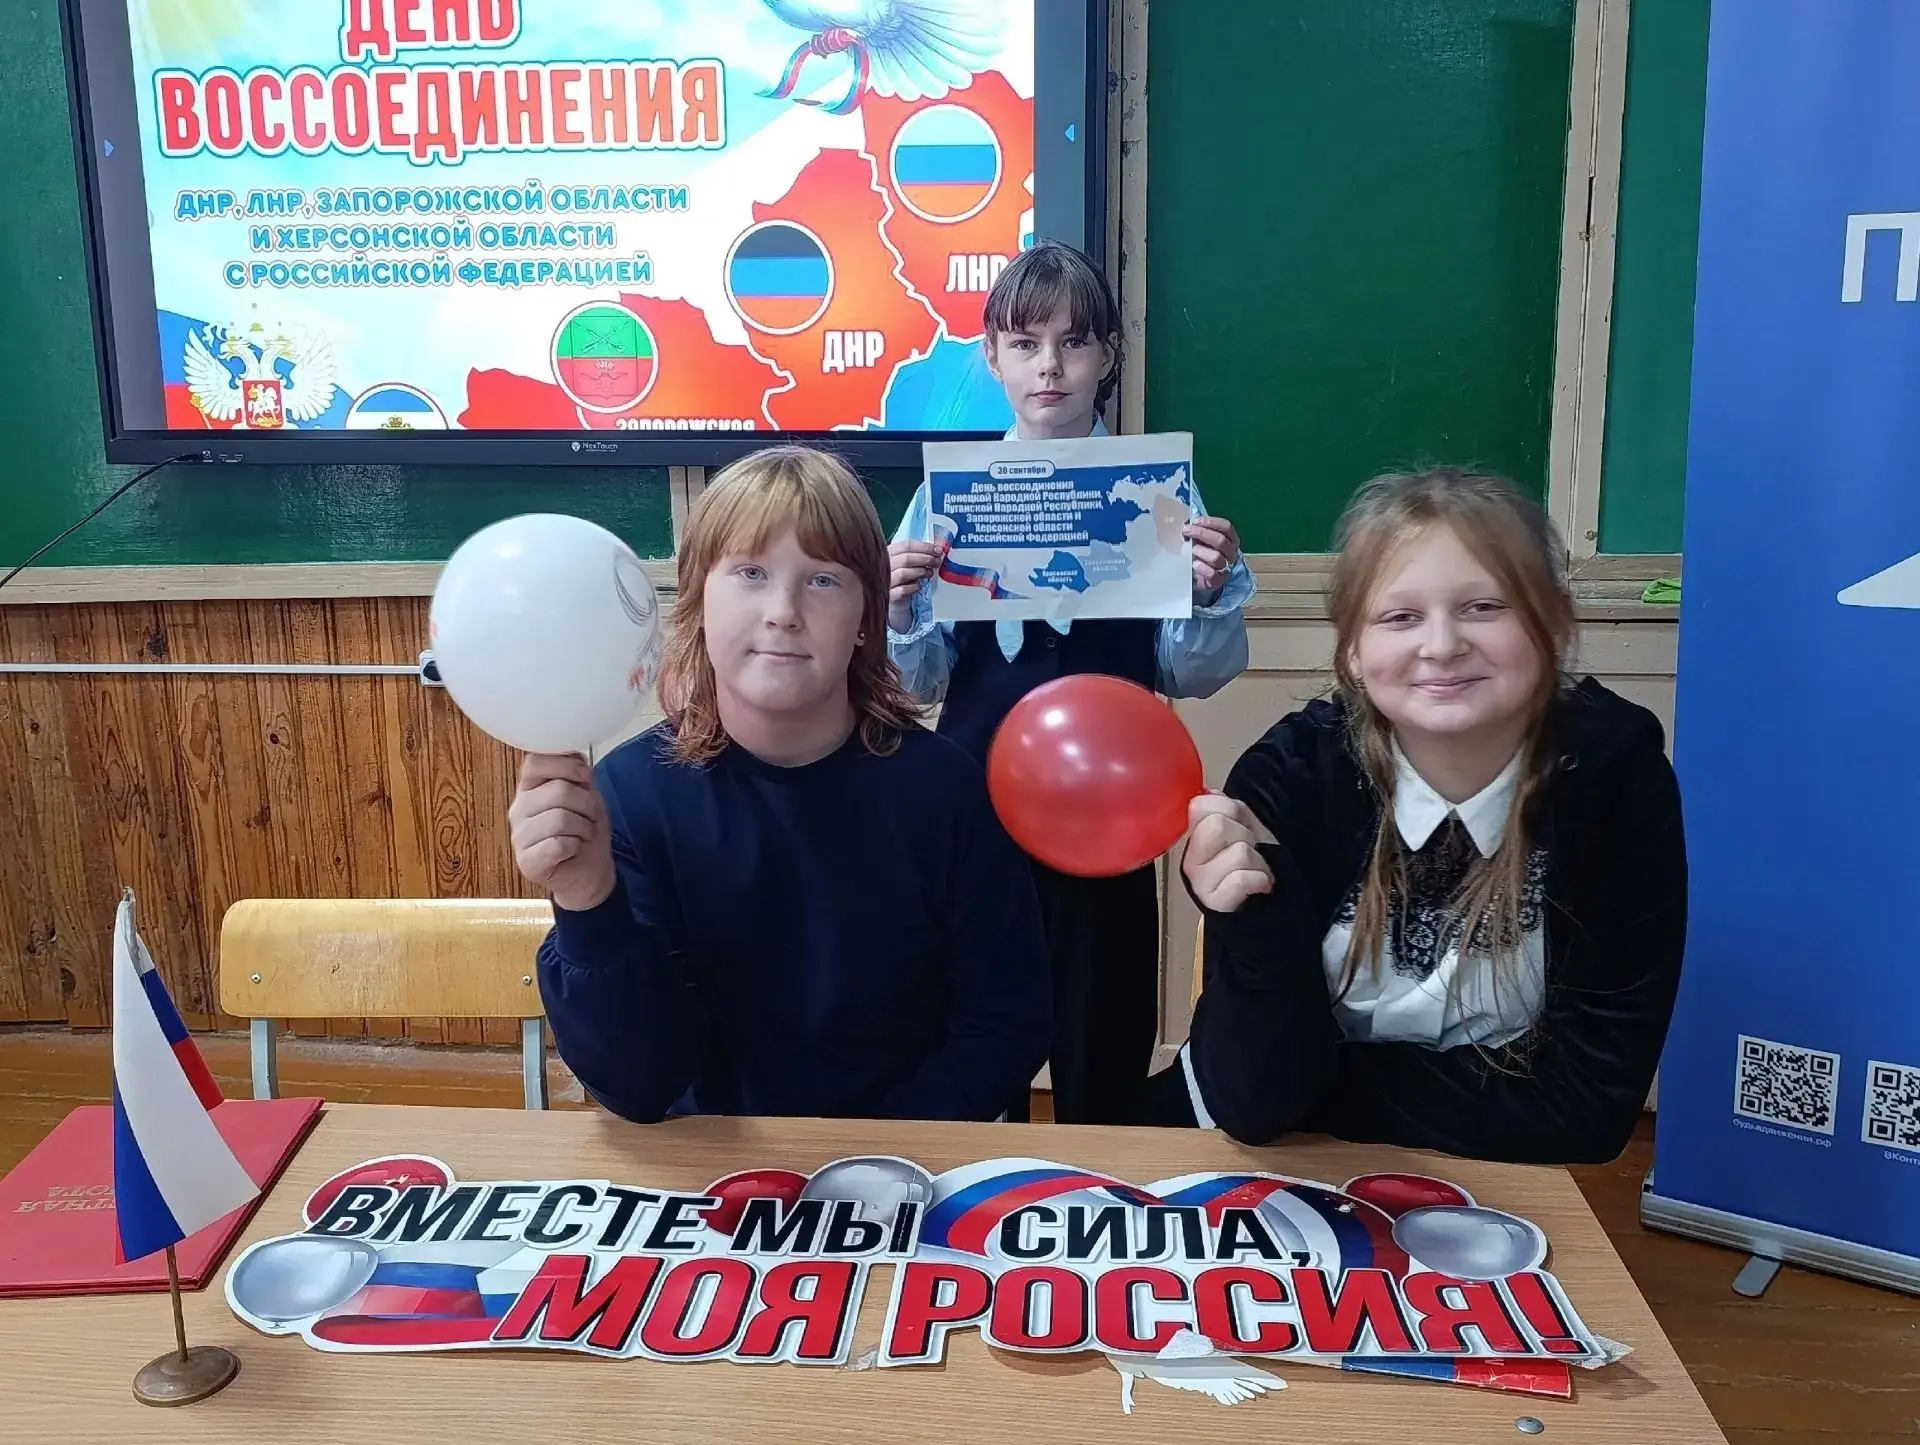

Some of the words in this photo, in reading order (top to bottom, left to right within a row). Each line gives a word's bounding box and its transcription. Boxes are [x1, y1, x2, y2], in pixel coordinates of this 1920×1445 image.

[160, 66, 721, 158] ВОССОЕДИНЕНИЯ
[177, 192, 241, 218] ДНР,
[247, 191, 311, 216] ЛНР,
[316, 181, 543, 213] ЗАПОРОЖСКОЙ
[550, 188, 687, 210] ОБЛАСТИ
[252, 227, 271, 249] И
[277, 219, 471, 249] ХЕРСОНСКОЙ
[479, 225, 614, 248] ОБЛАСТИ
[226, 264, 245, 286] С
[251, 254, 451, 285] РОССИЙСКОЙ
[458, 254, 651, 287] ФЕДЕРАЦИЕЙ
[822, 330, 886, 373] ДНР
[997, 466, 1008, 475] 30
[1009, 465, 1046, 475] сентября
[944, 492, 992, 504] Донецкой
[993, 490, 1041, 503] Народной
[971, 482, 996, 494] День
[998, 480, 1074, 492] воссоединения
[966, 512, 1032, 524] Запорожской
[1033, 511, 1073, 521] области
[994, 501, 1042, 513] Народной
[960, 534, 967, 543] с
[967, 532, 1025, 543] Российской
[1026, 530, 1089, 543] Федерацией
[975, 522, 1032, 534] Херсонской
[1033, 521, 1073, 532] области
[305, 1184, 722, 1251] ВМЕСТЕ
[731, 1198, 917, 1256] МЫ
[1000, 1204, 1320, 1266] СИЛА,
[492, 1254, 859, 1360] МОЯ
[888, 1263, 1585, 1361] РОССИЯ!
